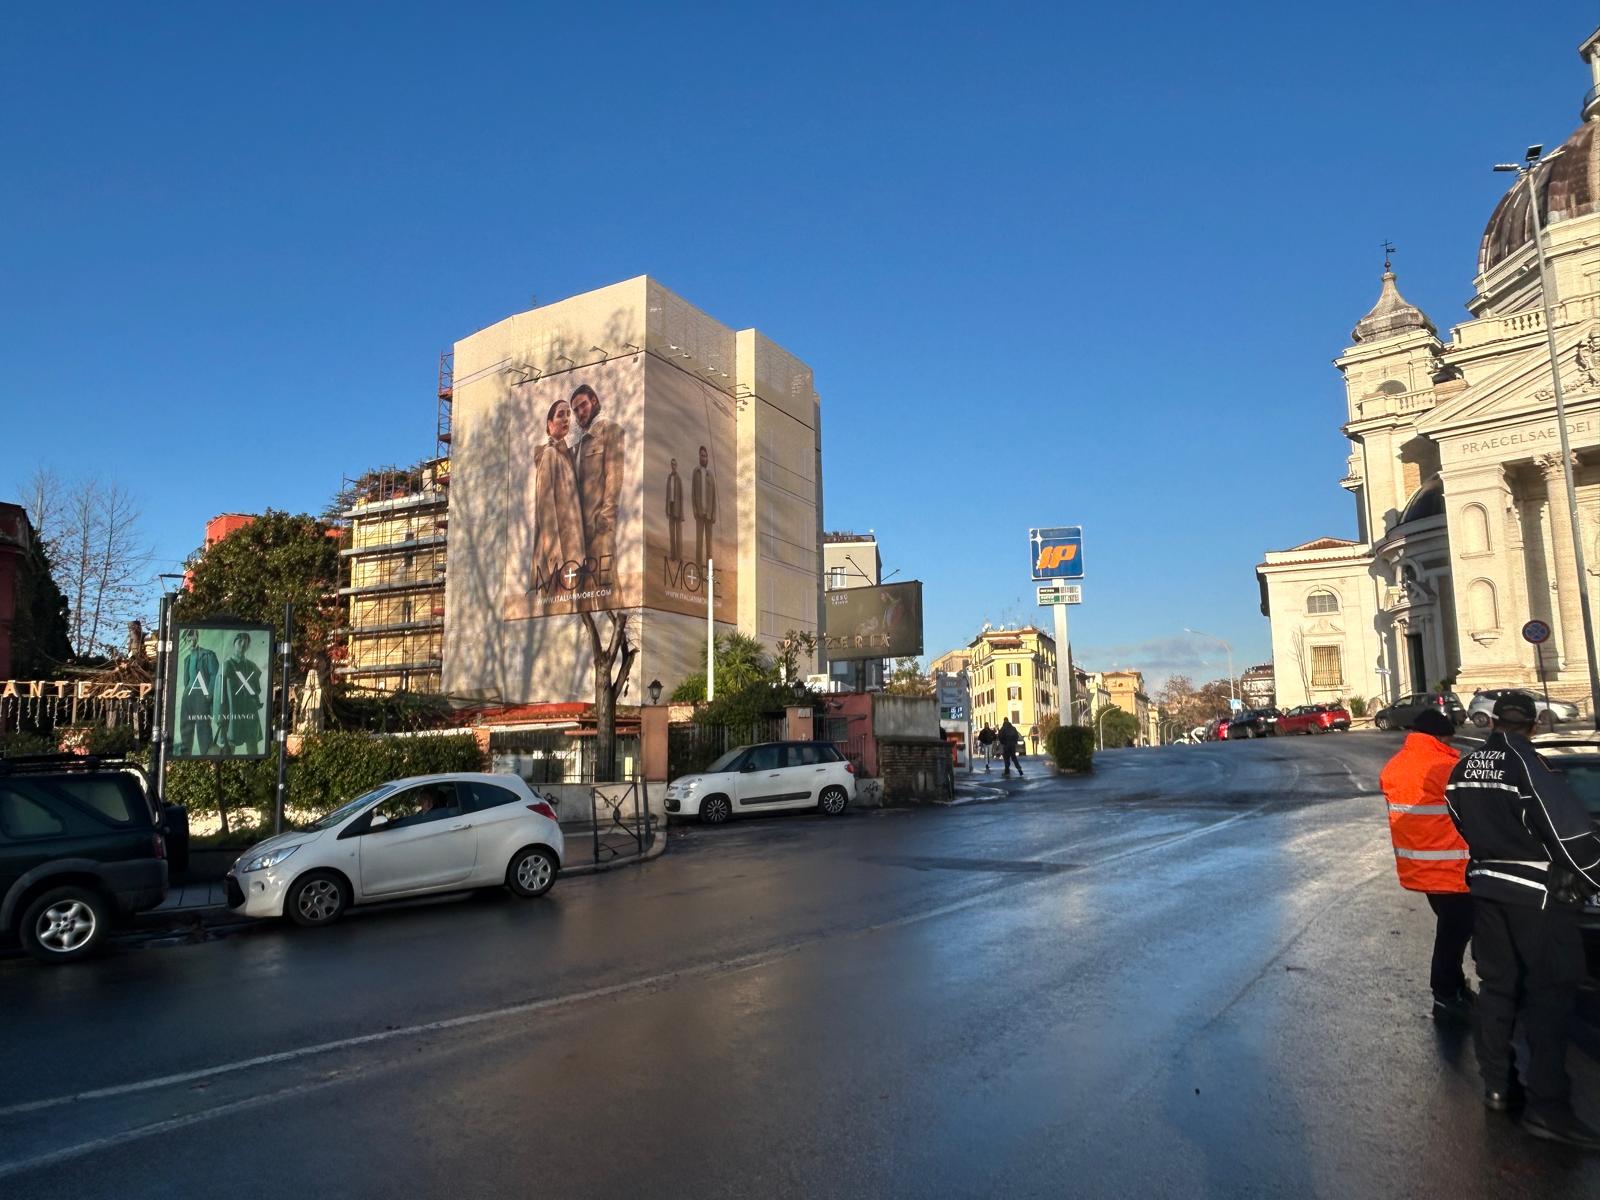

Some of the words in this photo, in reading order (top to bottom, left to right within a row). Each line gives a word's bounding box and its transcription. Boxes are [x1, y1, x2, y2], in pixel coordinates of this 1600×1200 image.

[1462, 427, 1557, 454] PRAECELSAE
[1566, 421, 1591, 435] DEI
[536, 554, 614, 595] MORE
[784, 633, 890, 649] PZERIA
[1469, 750, 1506, 760] POLIZIA
[1466, 760, 1494, 769] ROMA
[1464, 769, 1506, 780] CAPITALE
